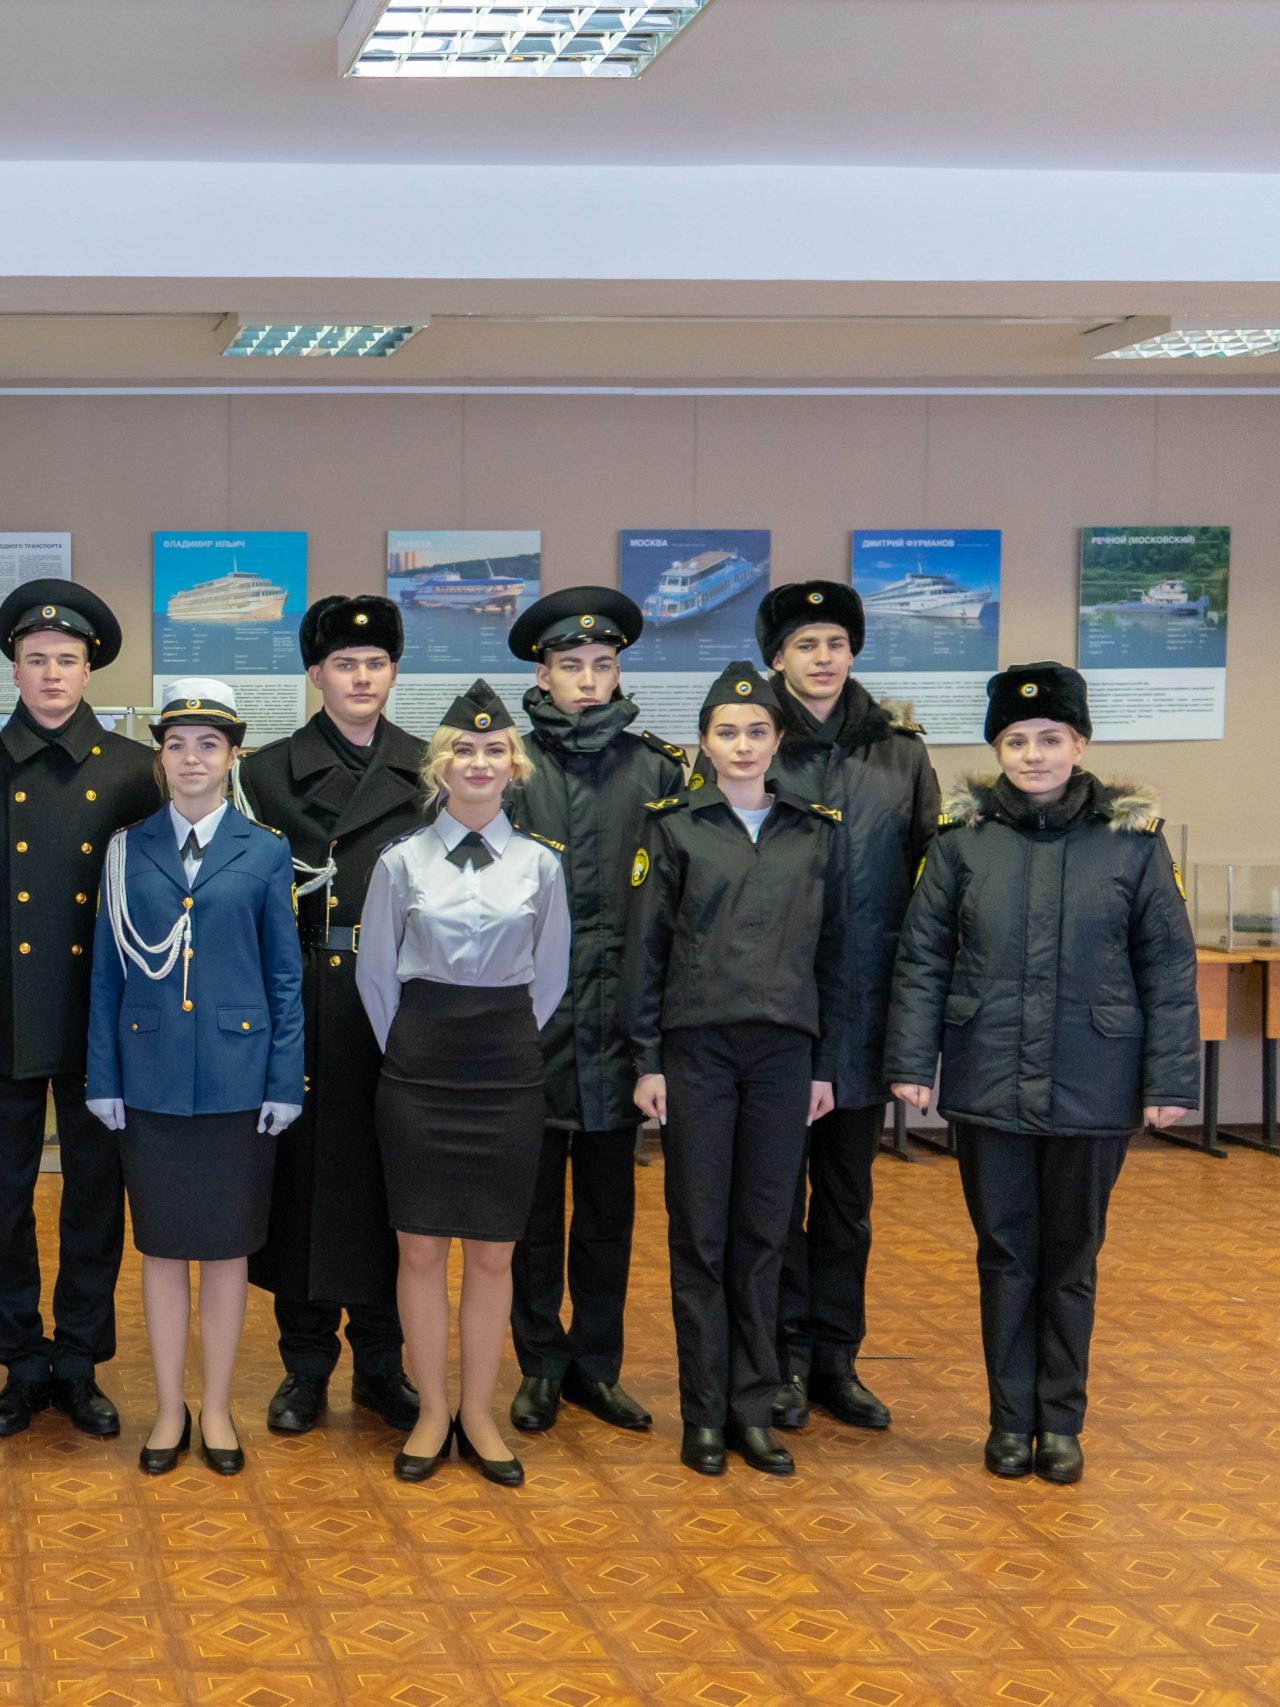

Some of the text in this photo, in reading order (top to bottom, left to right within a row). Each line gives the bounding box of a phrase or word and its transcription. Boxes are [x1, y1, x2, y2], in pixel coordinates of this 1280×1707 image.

[163, 540, 213, 549] ВЛАДИМИР
[215, 540, 245, 548] ИЛЬИЧ
[630, 539, 668, 547] МОСКВА
[862, 538, 904, 548] ДМИТРИЙ
[905, 539, 955, 548] ФУРМАНОВ
[1091, 536, 1127, 545] РЕЧНОЙ
[1128, 535, 1196, 546] (МОСКОВСКИЙ)
